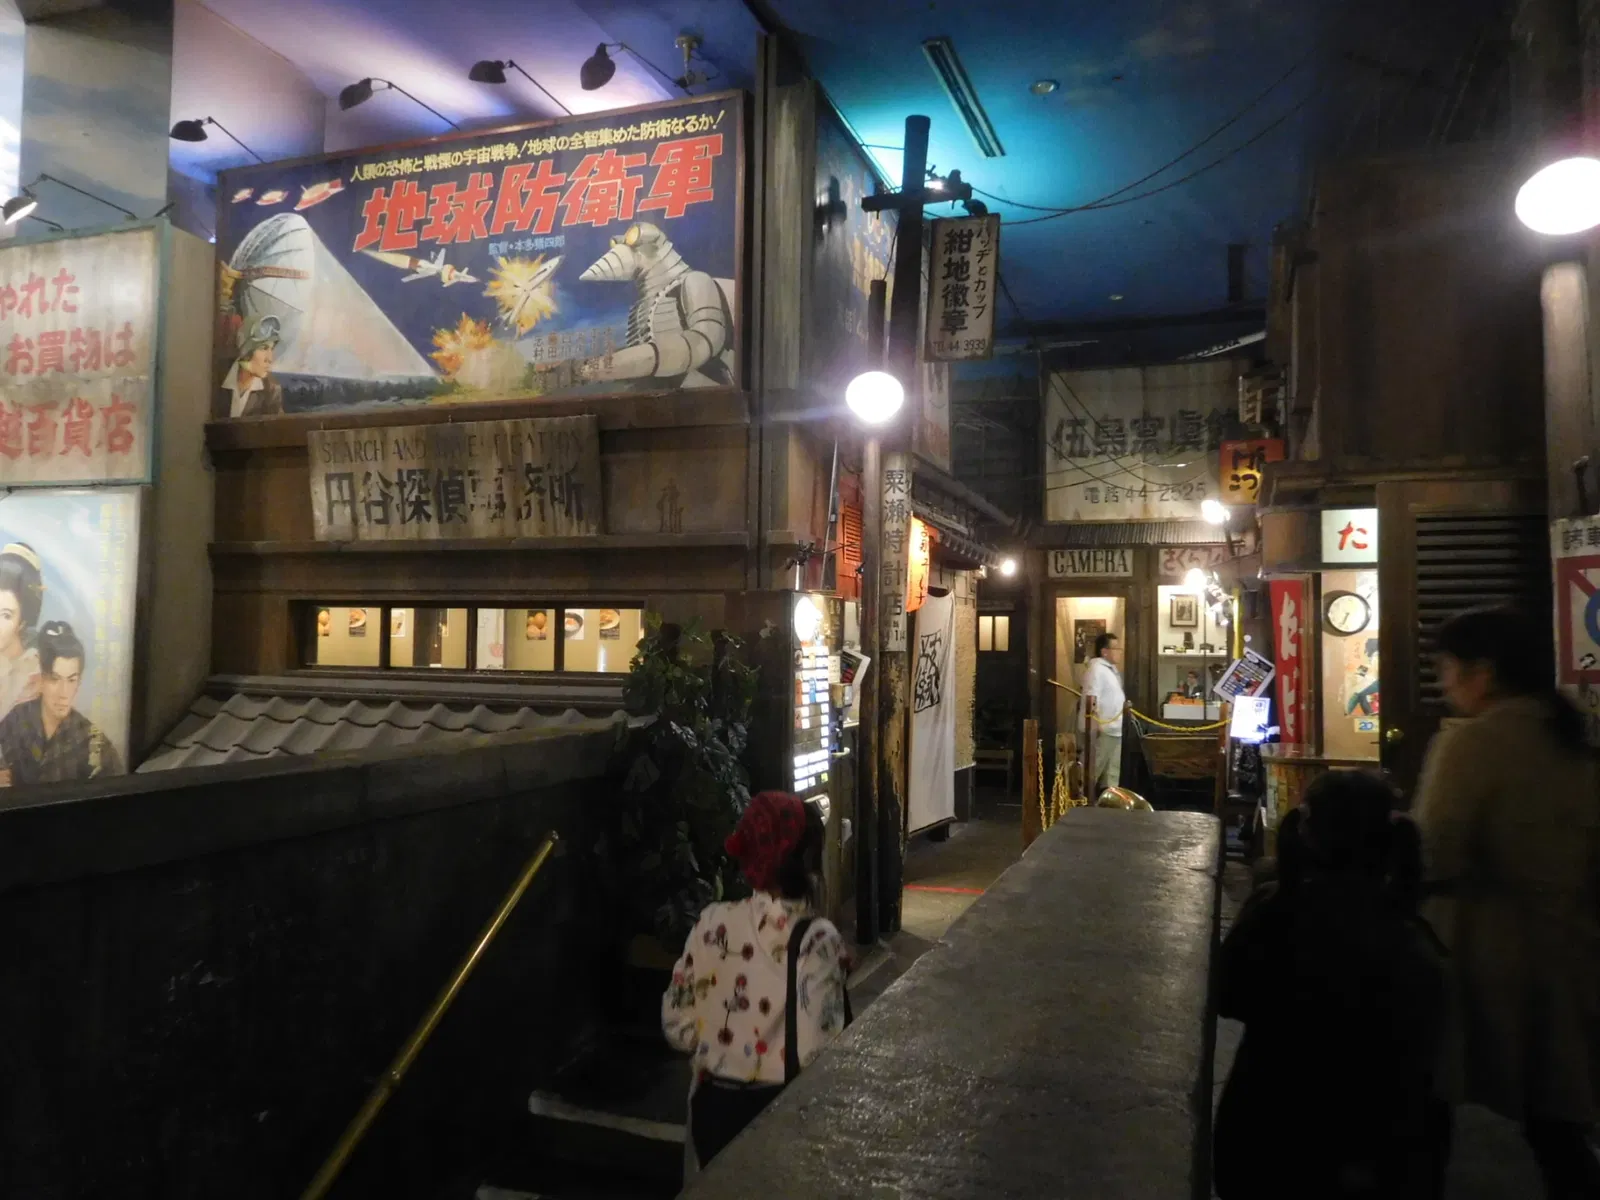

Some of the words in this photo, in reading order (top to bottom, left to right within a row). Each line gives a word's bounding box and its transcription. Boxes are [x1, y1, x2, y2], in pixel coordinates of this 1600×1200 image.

[352, 133, 723, 252] 地球防衛軍
[5, 322, 136, 376] お買物は
[322, 440, 384, 463] SEARCH
[1126, 484, 1147, 503] 44
[1159, 482, 1206, 502] 2525
[1338, 520, 1369, 551] た
[1055, 550, 1129, 573] CAMERA
